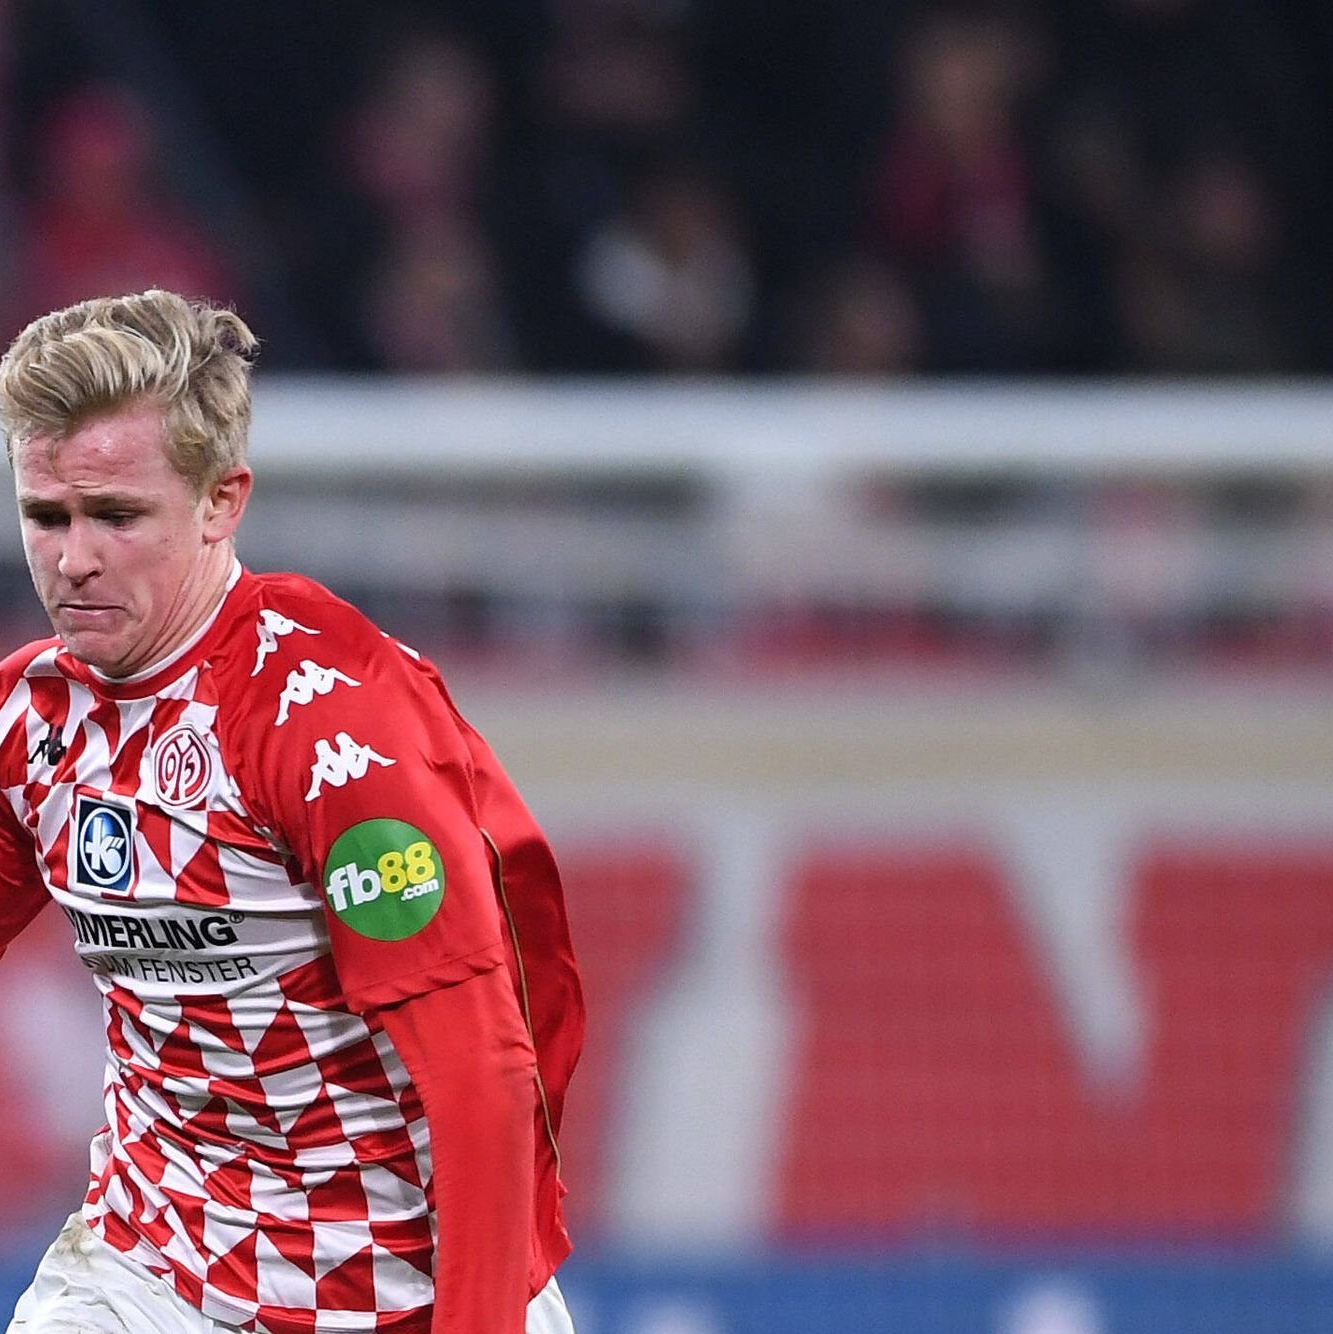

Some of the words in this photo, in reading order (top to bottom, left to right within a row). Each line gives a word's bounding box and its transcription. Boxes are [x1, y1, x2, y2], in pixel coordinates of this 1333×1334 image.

[326, 841, 436, 912] fb88
[400, 878, 439, 901] .com
[138, 957, 258, 984] FENSTER
